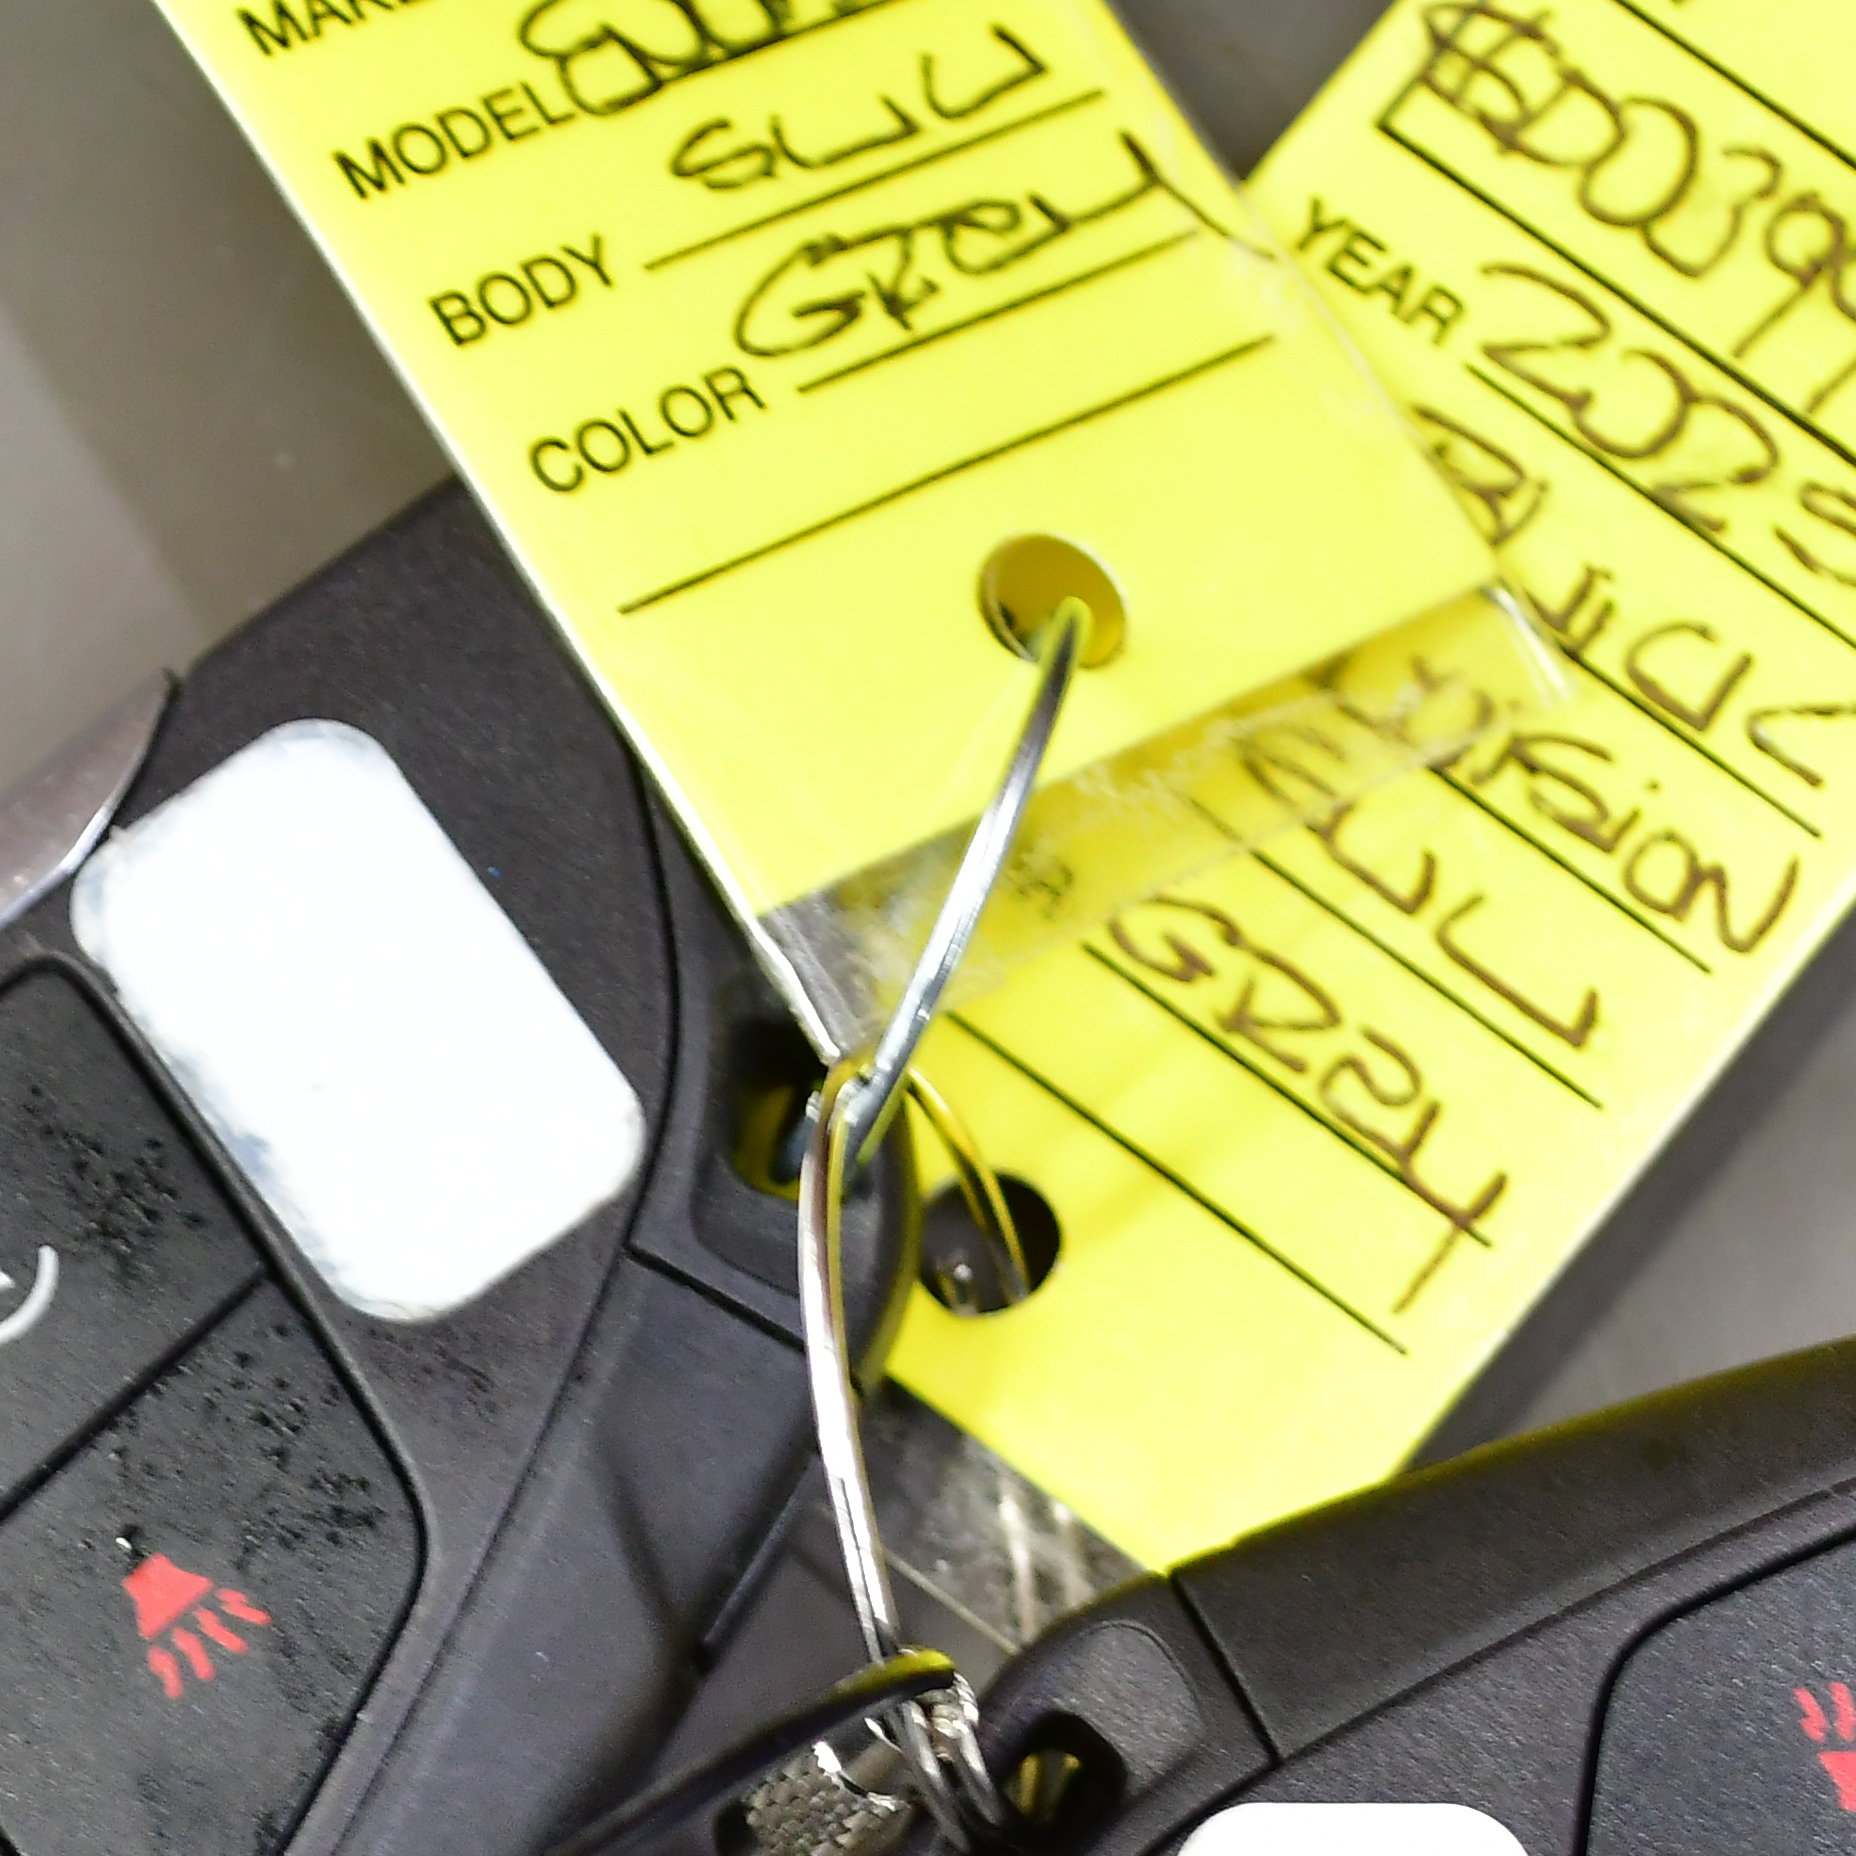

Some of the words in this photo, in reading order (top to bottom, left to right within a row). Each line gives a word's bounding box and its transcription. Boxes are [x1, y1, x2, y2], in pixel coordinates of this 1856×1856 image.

[332, 80, 576, 200] MODEL
[428, 232, 613, 347] BODY
[1294, 197, 1467, 350] YEAR
[529, 363, 767, 494] COLOR
